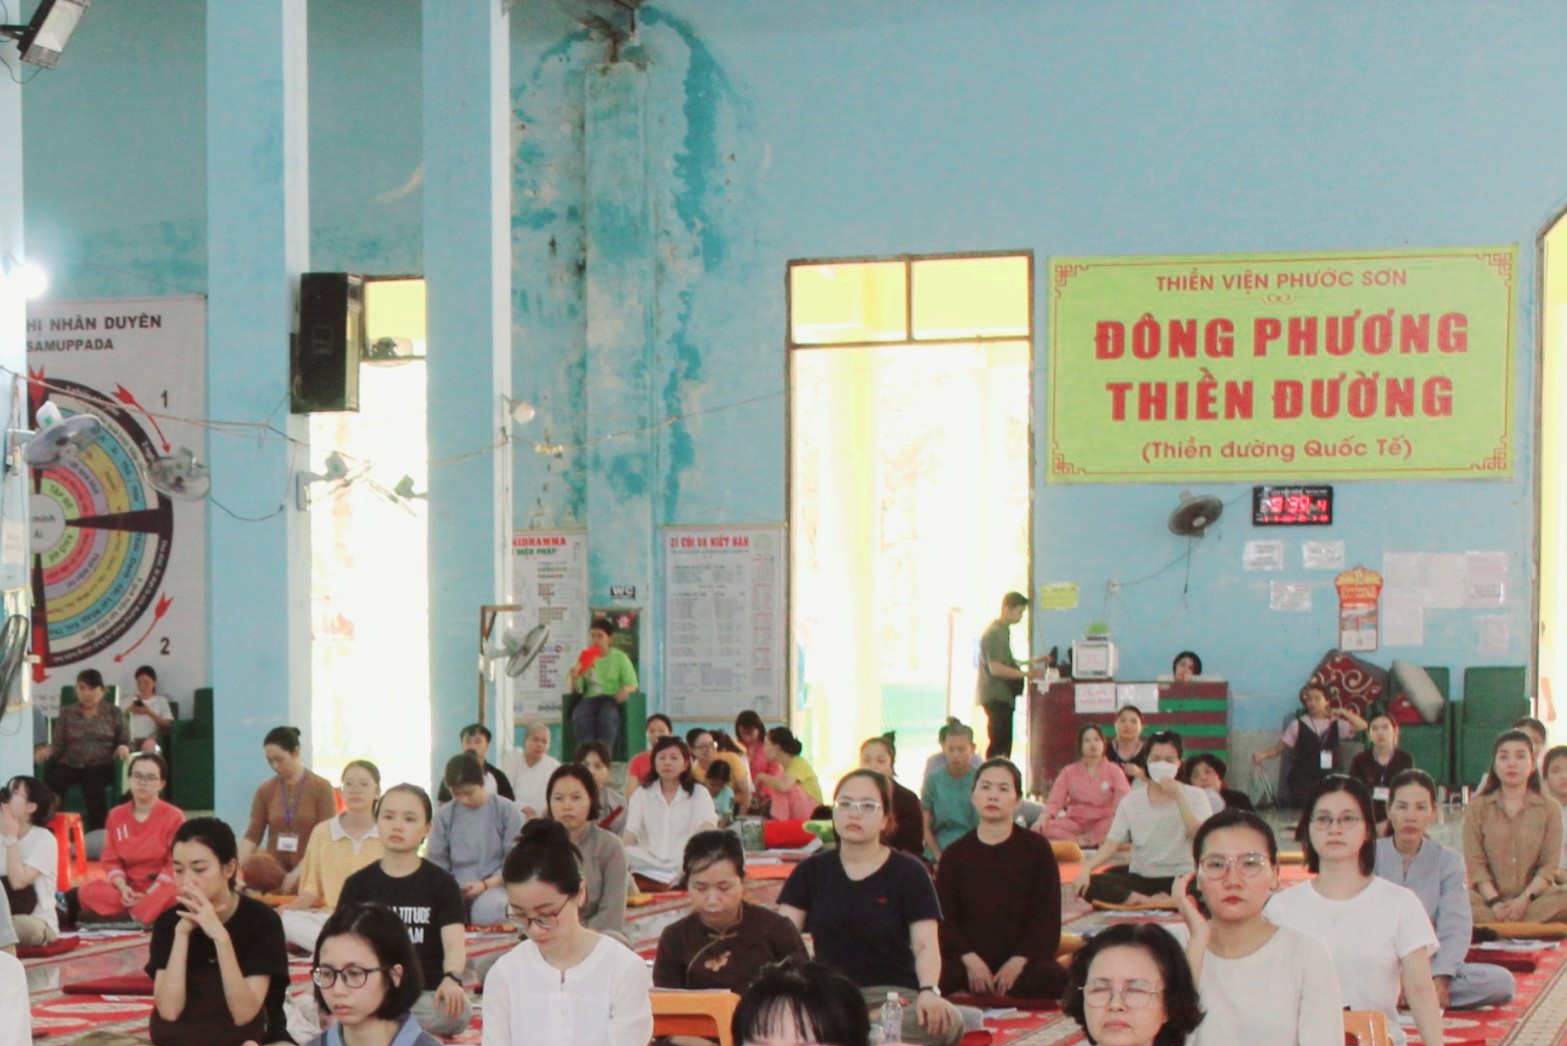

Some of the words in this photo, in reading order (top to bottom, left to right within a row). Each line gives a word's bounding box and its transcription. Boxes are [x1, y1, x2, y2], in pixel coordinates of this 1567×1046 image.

[1156, 267, 1214, 291] THIỀN
[1222, 270, 1269, 294] VIỆN
[1277, 267, 1354, 288] PHƯỚC
[1362, 269, 1407, 286] SƠN
[27, 319, 43, 336] HỊ
[50, 315, 97, 331] NHÂN
[104, 313, 162, 330] DUYÊN
[1093, 312, 1234, 359] ĐÔNG
[1253, 308, 1468, 357] PHƯƠNG
[160, 389, 169, 408] 1
[1105, 367, 1254, 421] THIỀN
[1271, 371, 1453, 420] ĐƯỜNG
[1141, 436, 1212, 464] (Thiền
[1220, 440, 1296, 462] đường
[1304, 435, 1368, 458] Quốc
[1376, 434, 1413, 460] Tế)
[160, 636, 170, 656] 2
